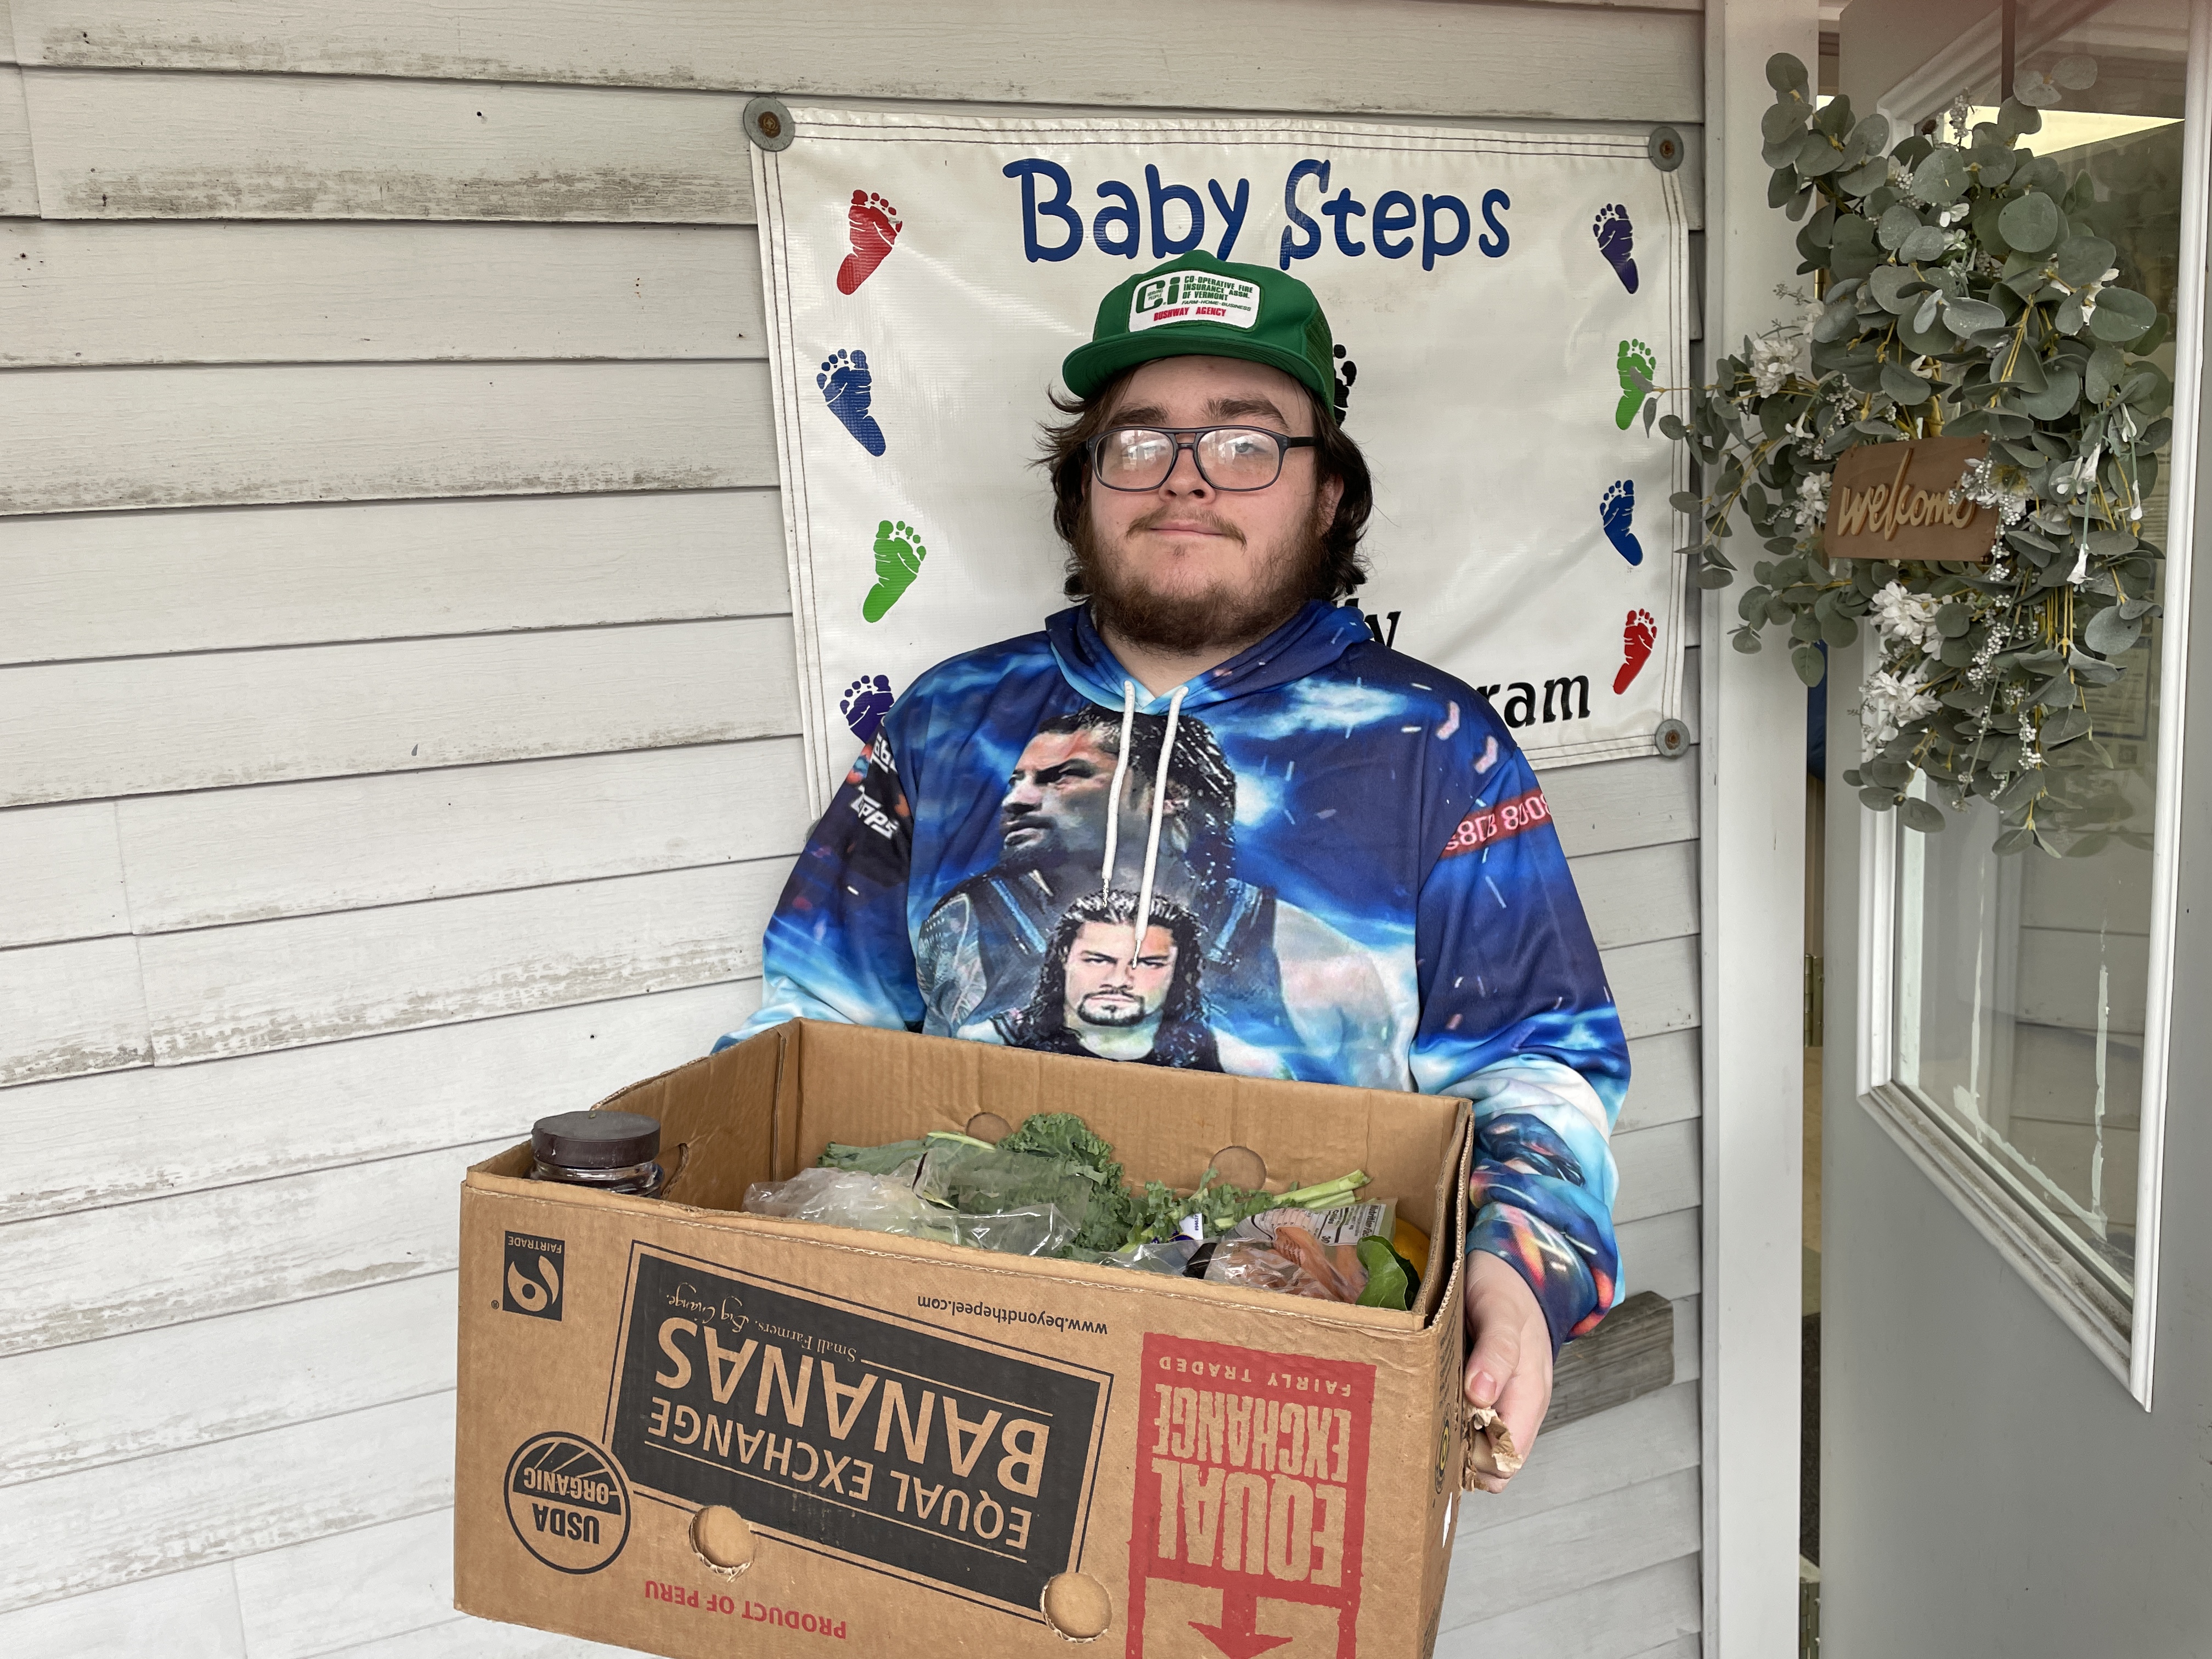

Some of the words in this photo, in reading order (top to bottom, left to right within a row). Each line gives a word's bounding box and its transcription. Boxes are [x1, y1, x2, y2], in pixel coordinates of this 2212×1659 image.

[1002, 158, 1250, 263] Baby
[1279, 159, 1511, 272] Steps
[1183, 283, 1225, 294] INSURANCE
[1228, 289, 1250, 298] ASSN.
[1184, 275, 1235, 290] CO-OPERATIVE
[1238, 284, 1254, 293] FIRE
[1194, 291, 1228, 301] VERMONT
[1154, 307, 1189, 321] BUSHWAY
[1196, 307, 1226, 317] AGENCY
[1477, 674, 1591, 729] ram
[507, 1235, 562, 1254] FAIRTRADE
[720, 1295, 749, 1333] Big
[917, 1295, 1108, 1335] www.beyondthepeel.com
[755, 1319, 814, 1350] Farmers.
[817, 1339, 857, 1363] Small
[1159, 1356, 1251, 1383] TRADED
[1267, 1372, 1351, 1397] FAIRLY
[655, 1316, 1050, 1499] BANANAS
[648, 1396, 875, 1503] EXCHANGE
[1152, 1383, 1352, 1483] EXCHANGE
[523, 1466, 610, 1505] ORGANIC
[532, 1503, 600, 1545] USDA
[890, 1470, 1034, 1551] EQUAL
[1151, 1457, 1347, 1588] EQUAL
[645, 1580, 699, 1608] PERU
[706, 1594, 735, 1615] OF
[742, 1600, 847, 1640] PRODUCT
